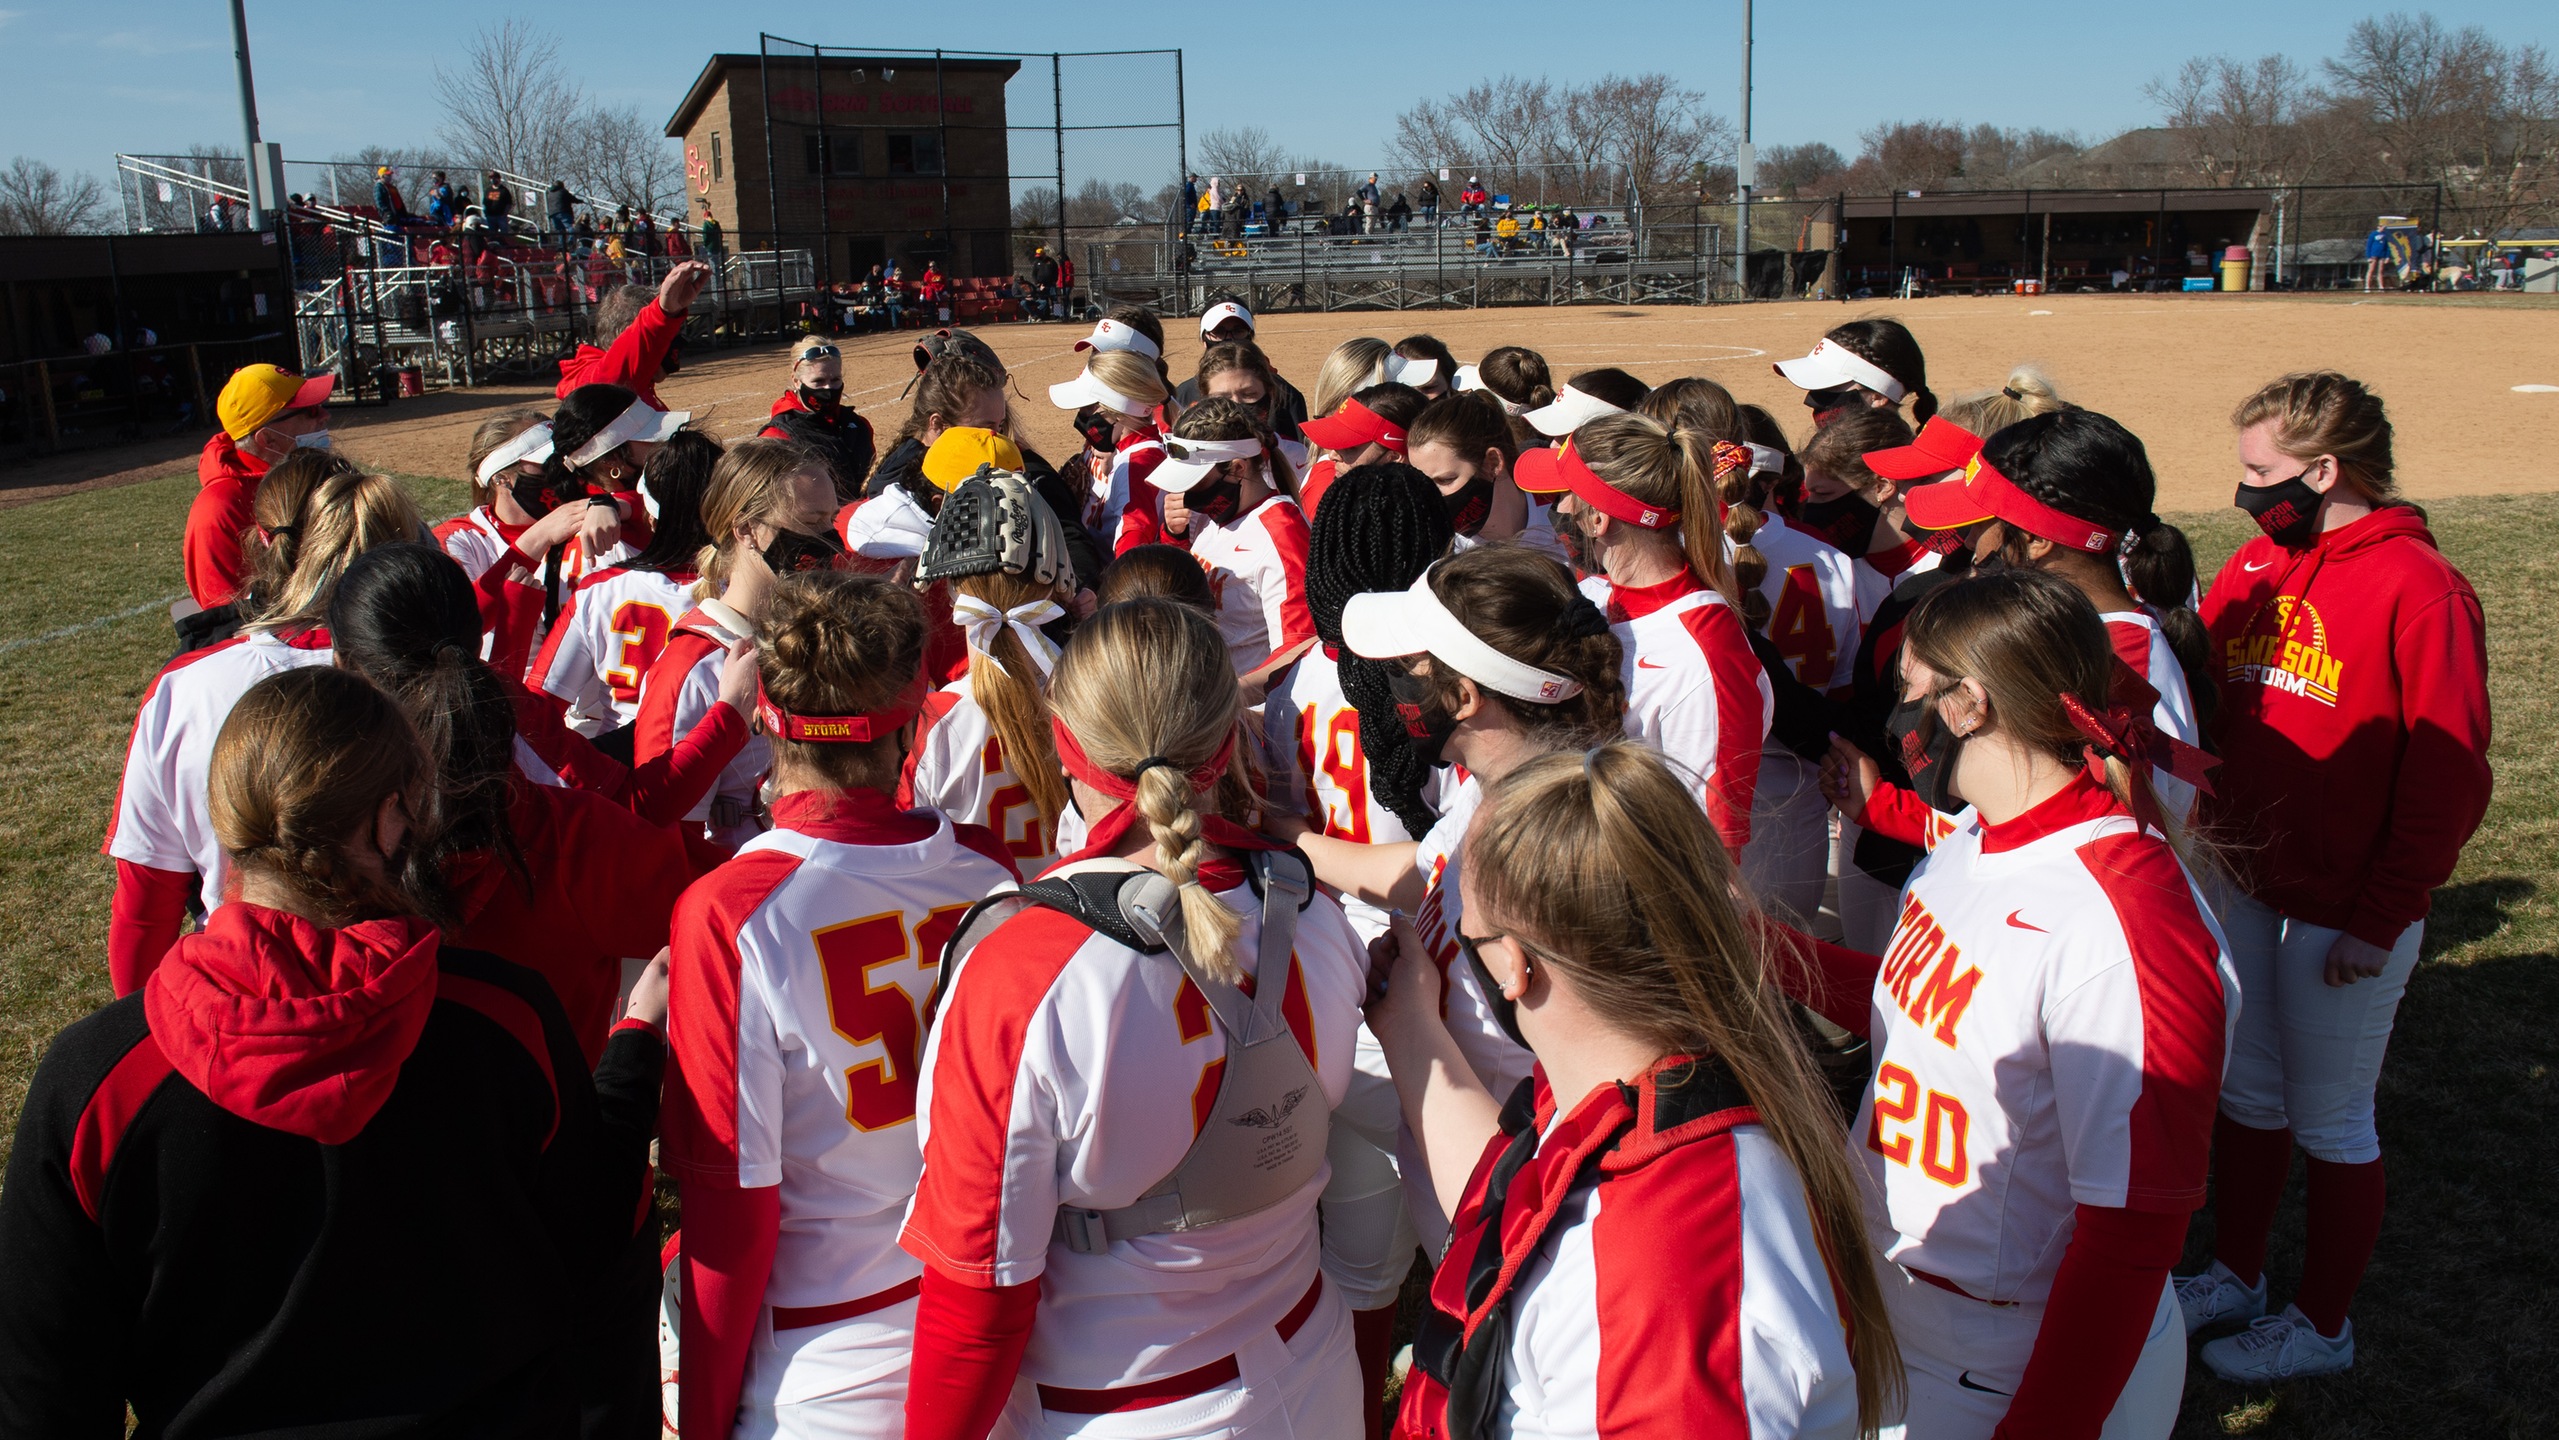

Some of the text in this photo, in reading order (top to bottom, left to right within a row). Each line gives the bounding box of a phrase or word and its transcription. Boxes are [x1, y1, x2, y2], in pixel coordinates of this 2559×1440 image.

[686, 144, 710, 194] SC
[1101, 321, 1111, 333] SC
[1010, 497, 1028, 545] Rawlings
[606, 600, 673, 704] 3
[1768, 563, 1837, 688] 4
[803, 723, 851, 737] STORM
[2244, 664, 2309, 698] STORM
[981, 735, 1058, 859] 2
[1294, 702, 1373, 844] 19
[1881, 889, 1985, 1050] TORM
[1868, 1060, 1970, 1189] 20
